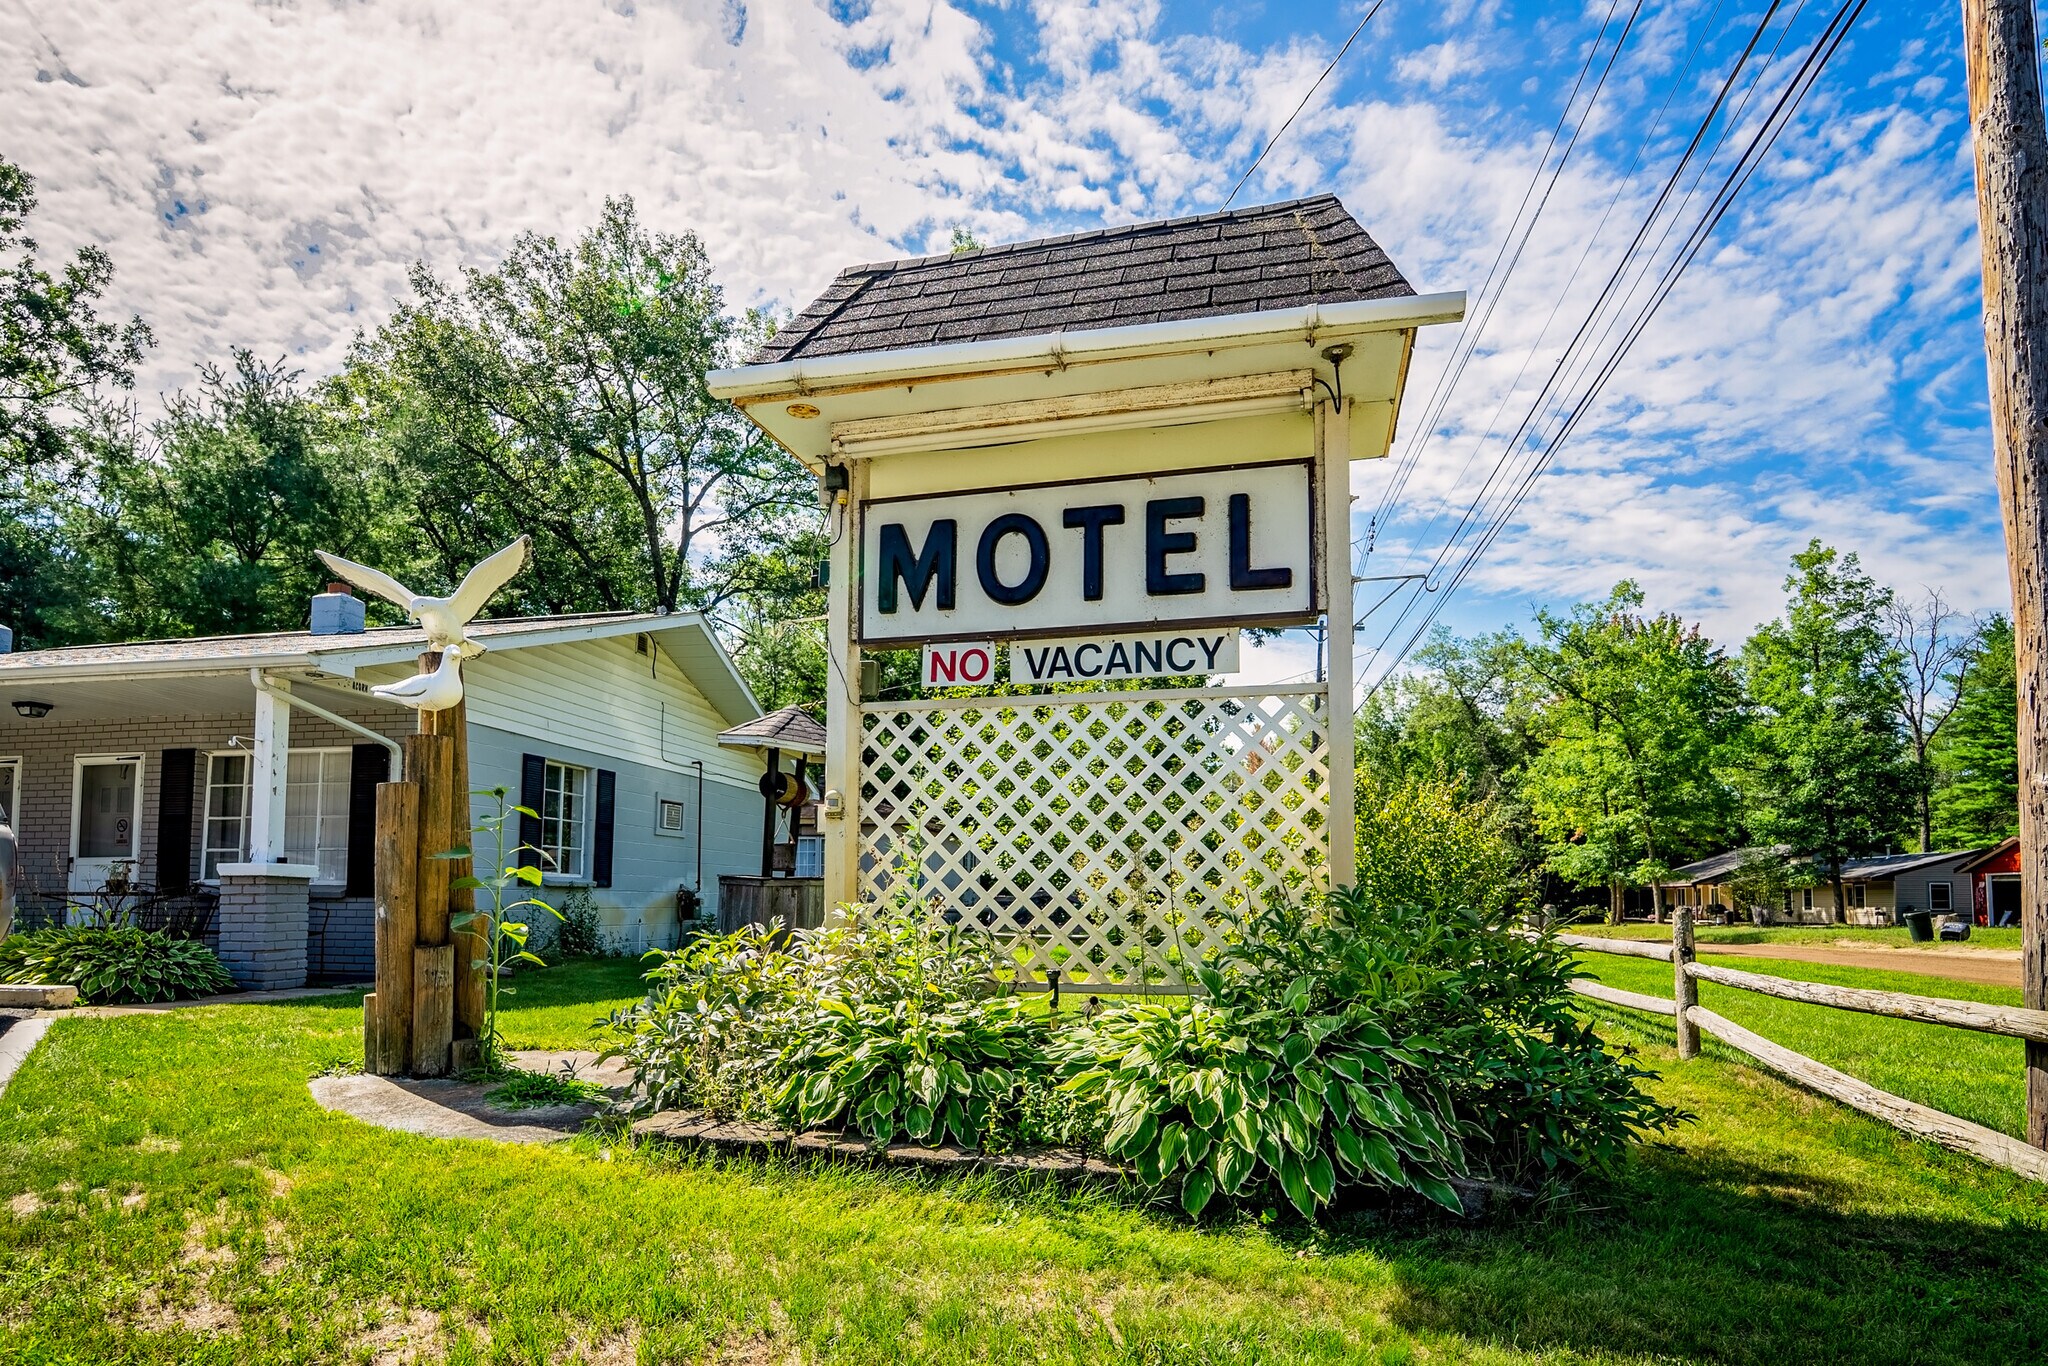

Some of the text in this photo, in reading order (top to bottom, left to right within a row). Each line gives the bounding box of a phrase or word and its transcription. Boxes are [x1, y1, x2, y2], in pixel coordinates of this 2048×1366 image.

[878, 493, 1292, 614] MOTEL
[930, 636, 1225, 683] NO VACANCY
